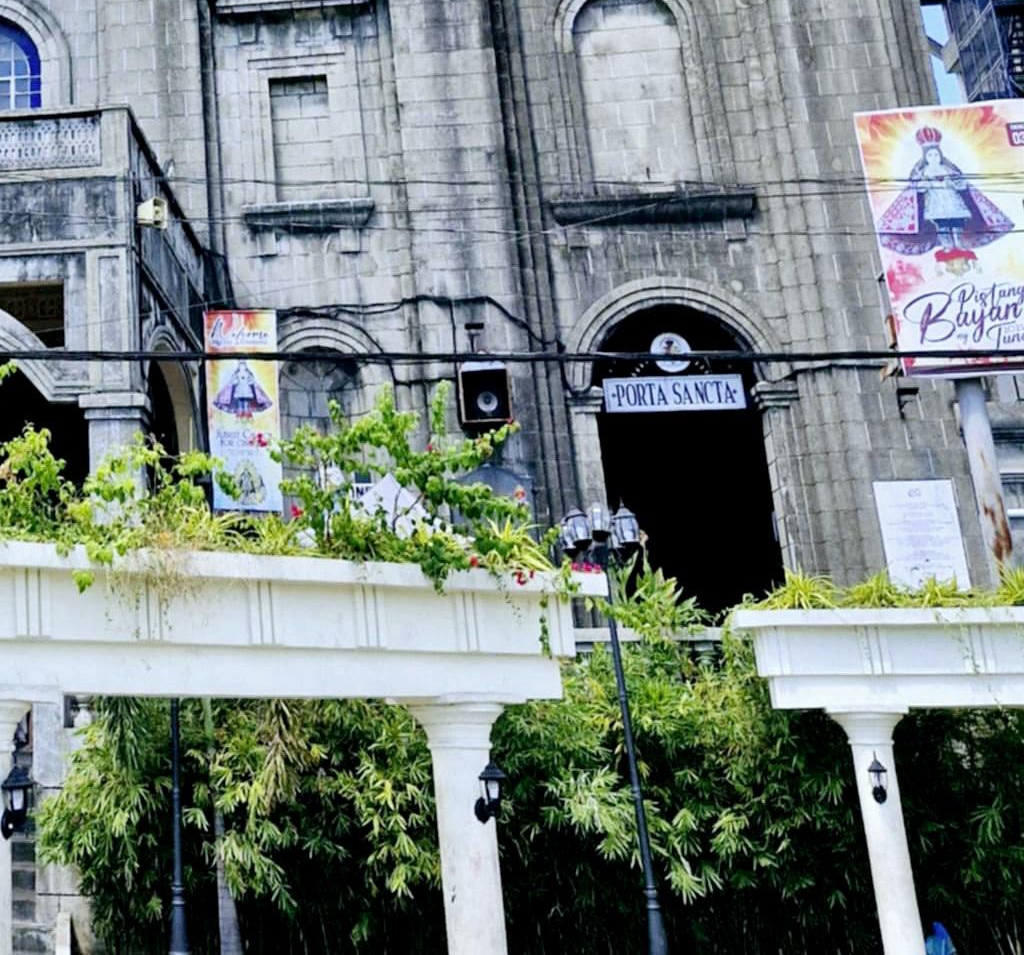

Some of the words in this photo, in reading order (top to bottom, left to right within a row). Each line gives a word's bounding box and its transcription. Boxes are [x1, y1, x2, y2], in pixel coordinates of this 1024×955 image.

[903, 291, 1023, 345] Bayan
[616, 383, 668, 408] PORTA
[672, 380, 737, 405] SANCTA
